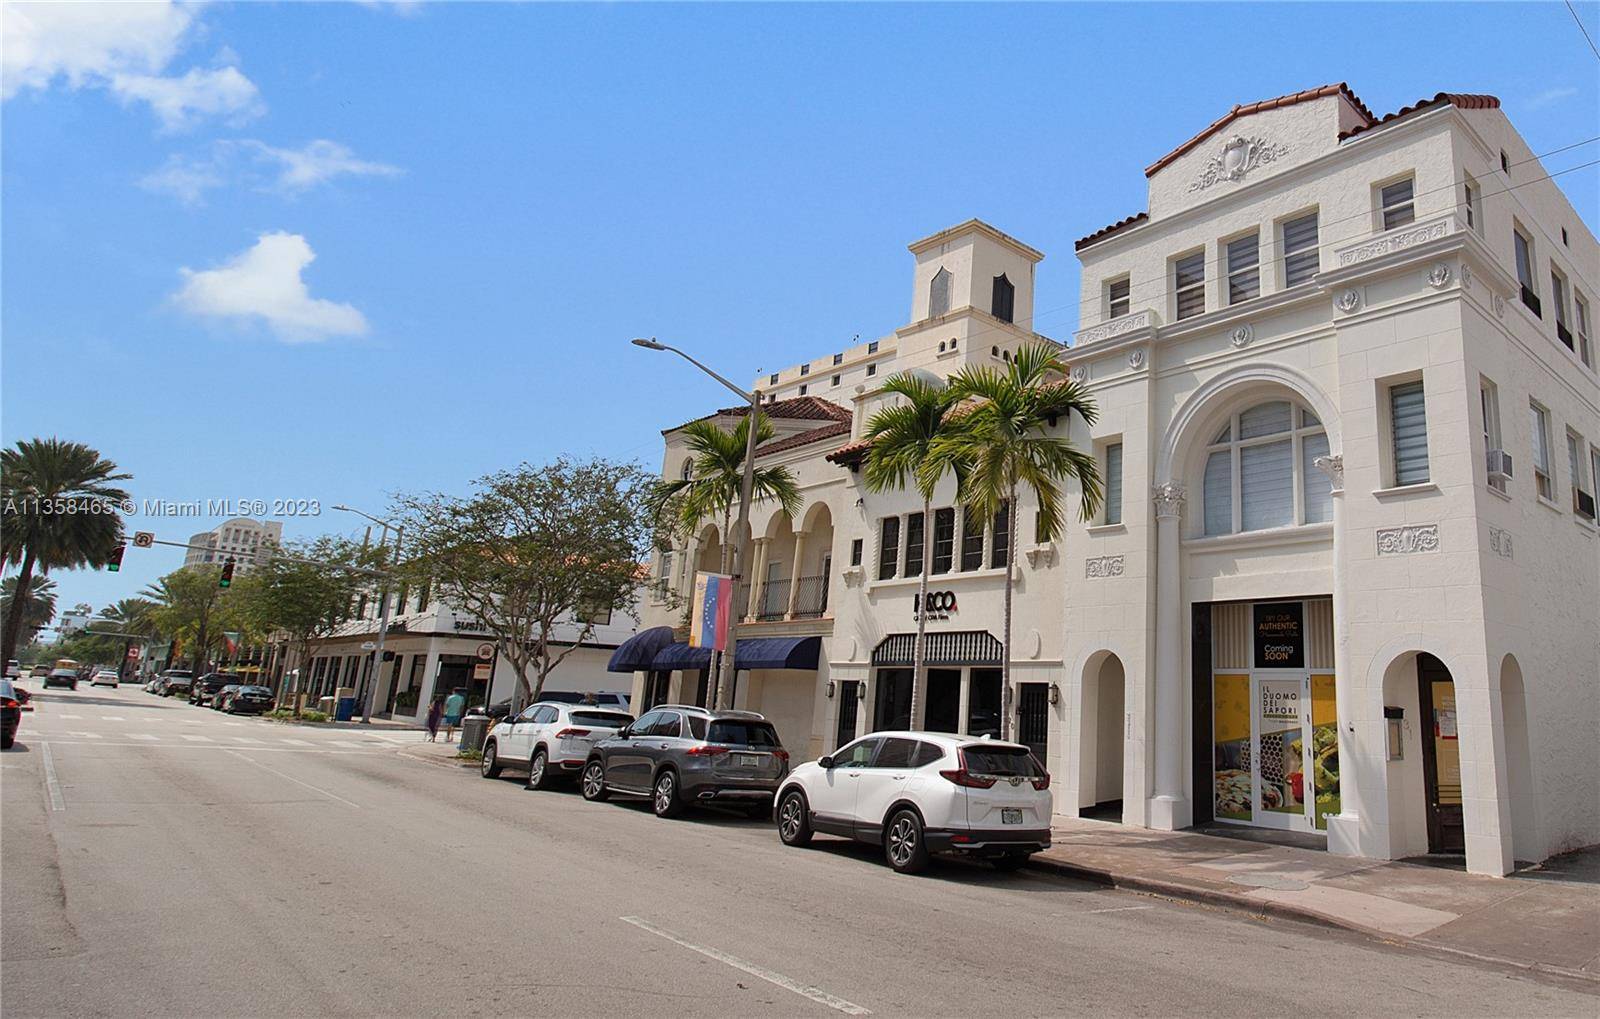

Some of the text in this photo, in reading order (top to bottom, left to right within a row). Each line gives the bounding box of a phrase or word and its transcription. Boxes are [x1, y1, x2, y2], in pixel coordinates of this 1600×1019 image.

[1259, 621, 1298, 630] AUTHENTIC
[1264, 644, 1294, 654] Coming
[1264, 652, 1289, 660] SOON
[1263, 692, 1297, 700] DUOMO
[1263, 706, 1297, 714] SAPORI
